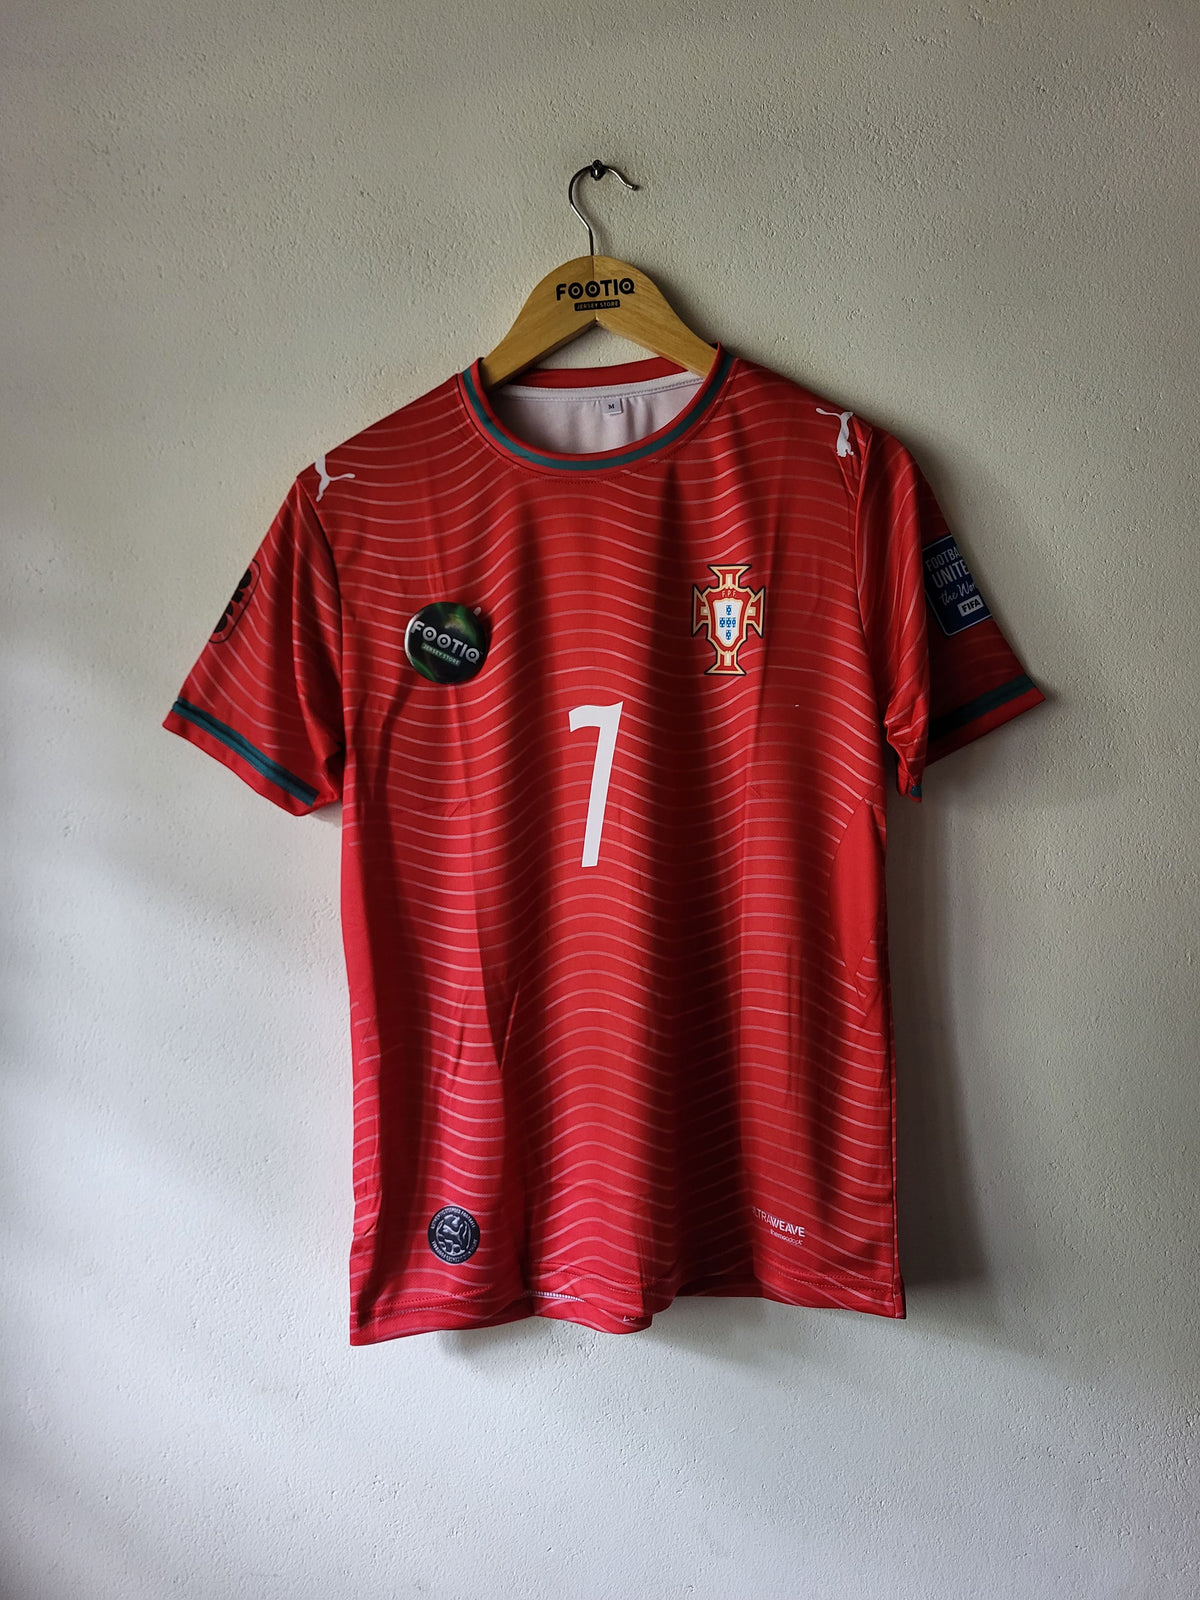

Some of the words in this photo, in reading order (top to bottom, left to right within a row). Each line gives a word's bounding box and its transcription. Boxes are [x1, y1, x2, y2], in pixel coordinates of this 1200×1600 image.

[555, 278, 635, 301] FOOTIQ
[576, 302, 598, 310] JERSEY
[600, 300, 619, 308] STORE
[961, 598, 981, 613] FIFA
[410, 620, 480, 665] FOOTIQ
[422, 643, 442, 657] JERSEY
[442, 652, 460, 666] STORE
[558, 701, 624, 868] 7
